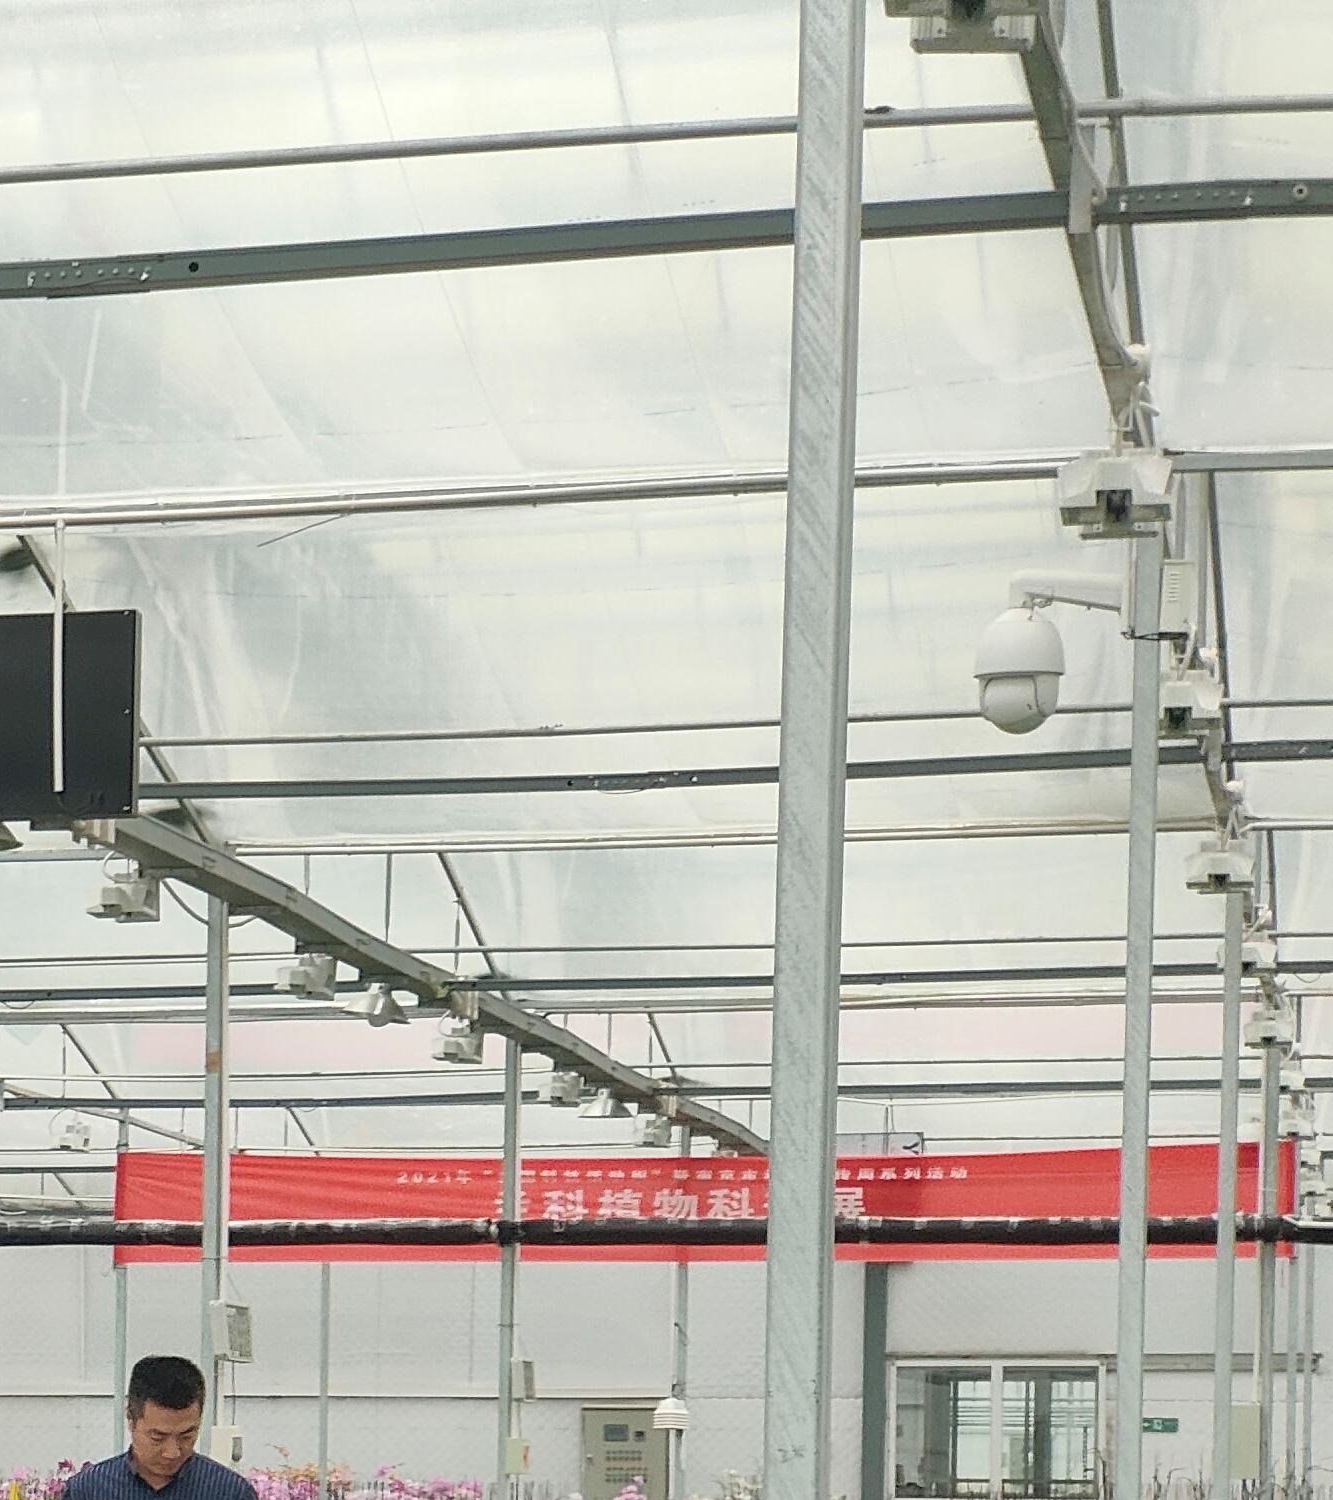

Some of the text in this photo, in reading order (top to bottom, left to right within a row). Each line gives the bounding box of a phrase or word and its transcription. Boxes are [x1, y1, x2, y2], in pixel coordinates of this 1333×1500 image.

[495, 1187, 865, 1219] 科植物科展
